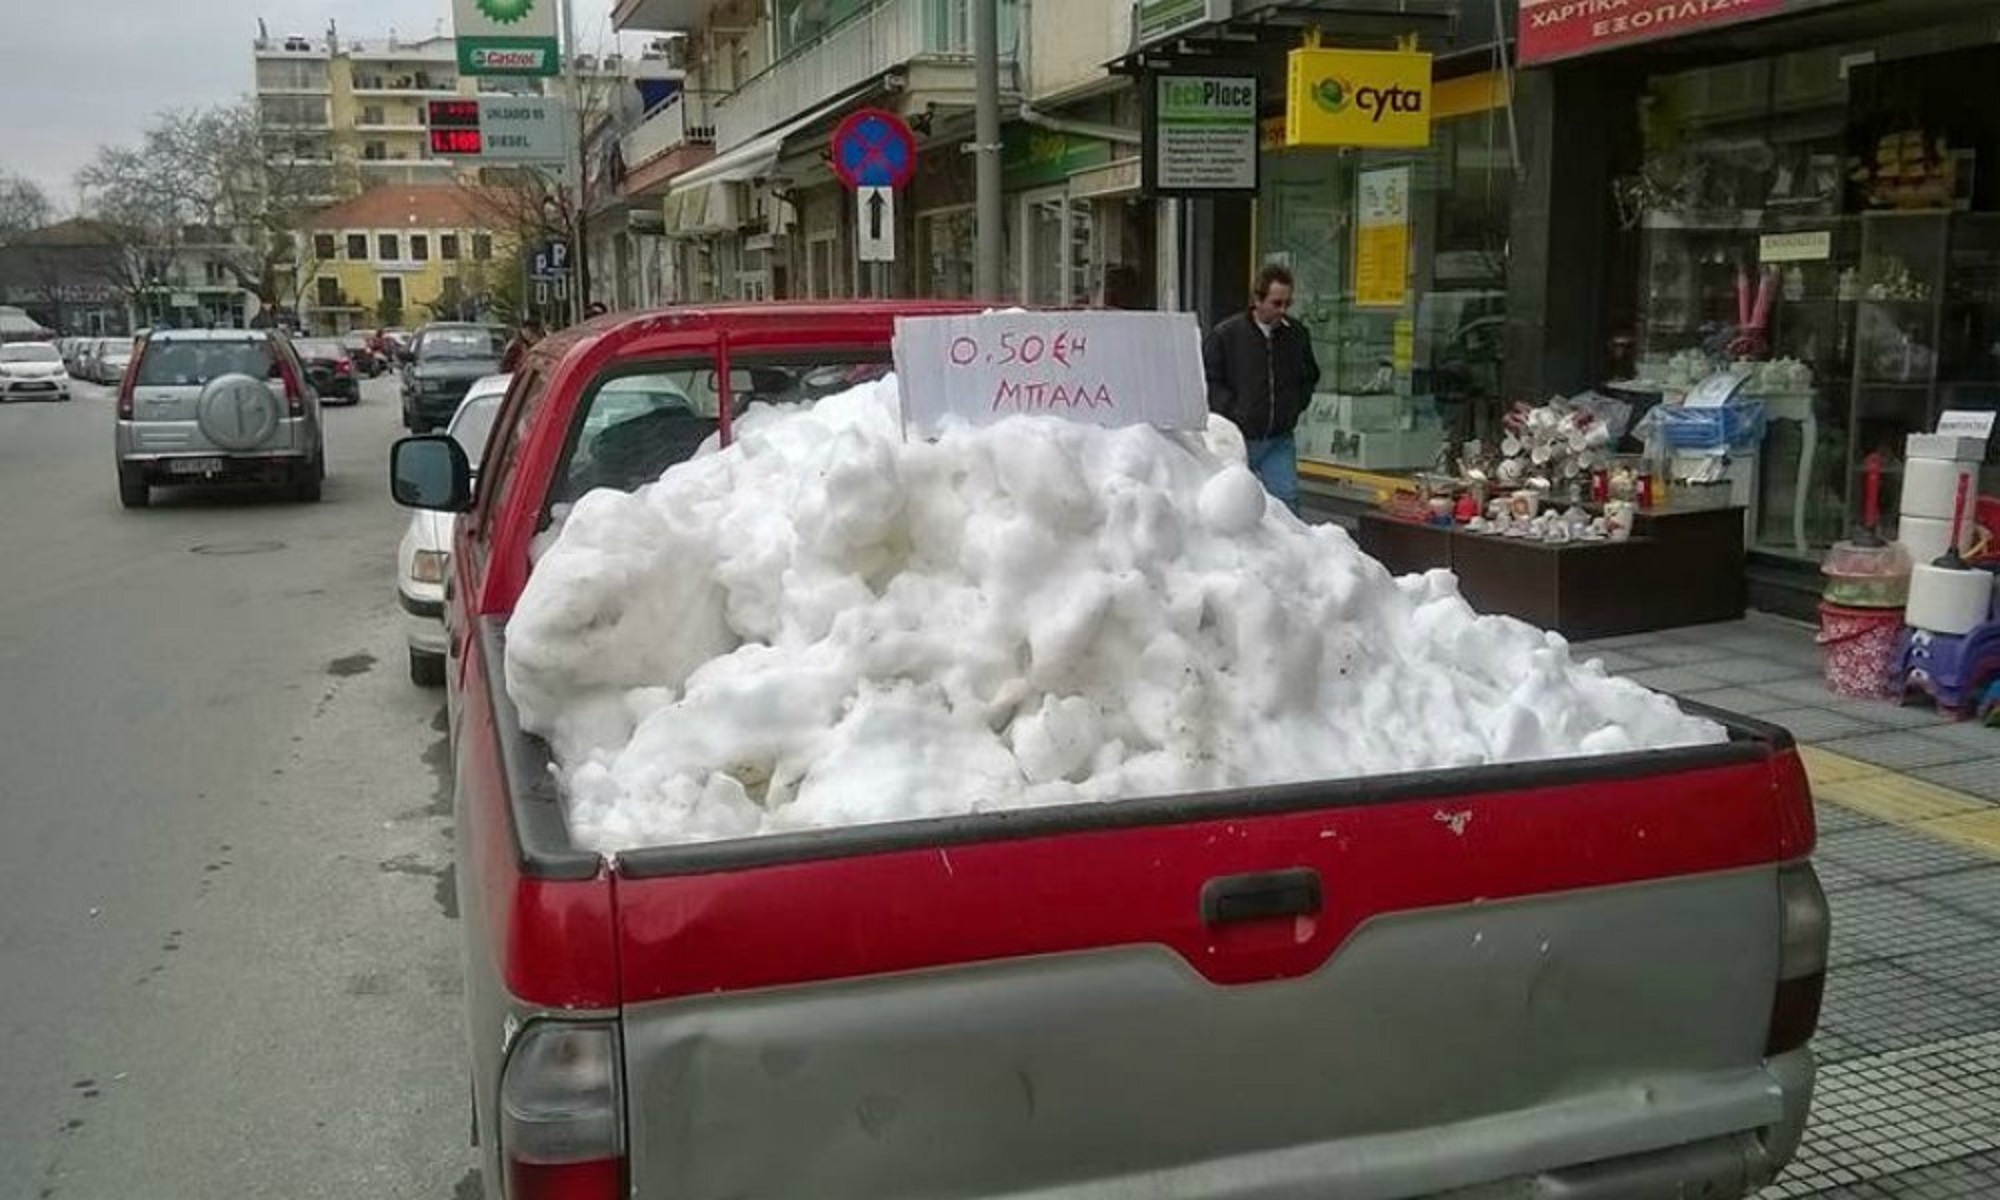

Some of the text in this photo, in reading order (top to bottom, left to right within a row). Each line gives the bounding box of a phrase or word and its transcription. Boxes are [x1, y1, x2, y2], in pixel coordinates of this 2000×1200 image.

[1593, 0, 1750, 37] ΕΞΟΠΛΙΣ
[1164, 81, 1252, 107] TechPlace
[1355, 83, 1422, 123] cyta
[552, 243, 567, 267] P
[992, 379, 1115, 412] ΜΠΑΛΑ
